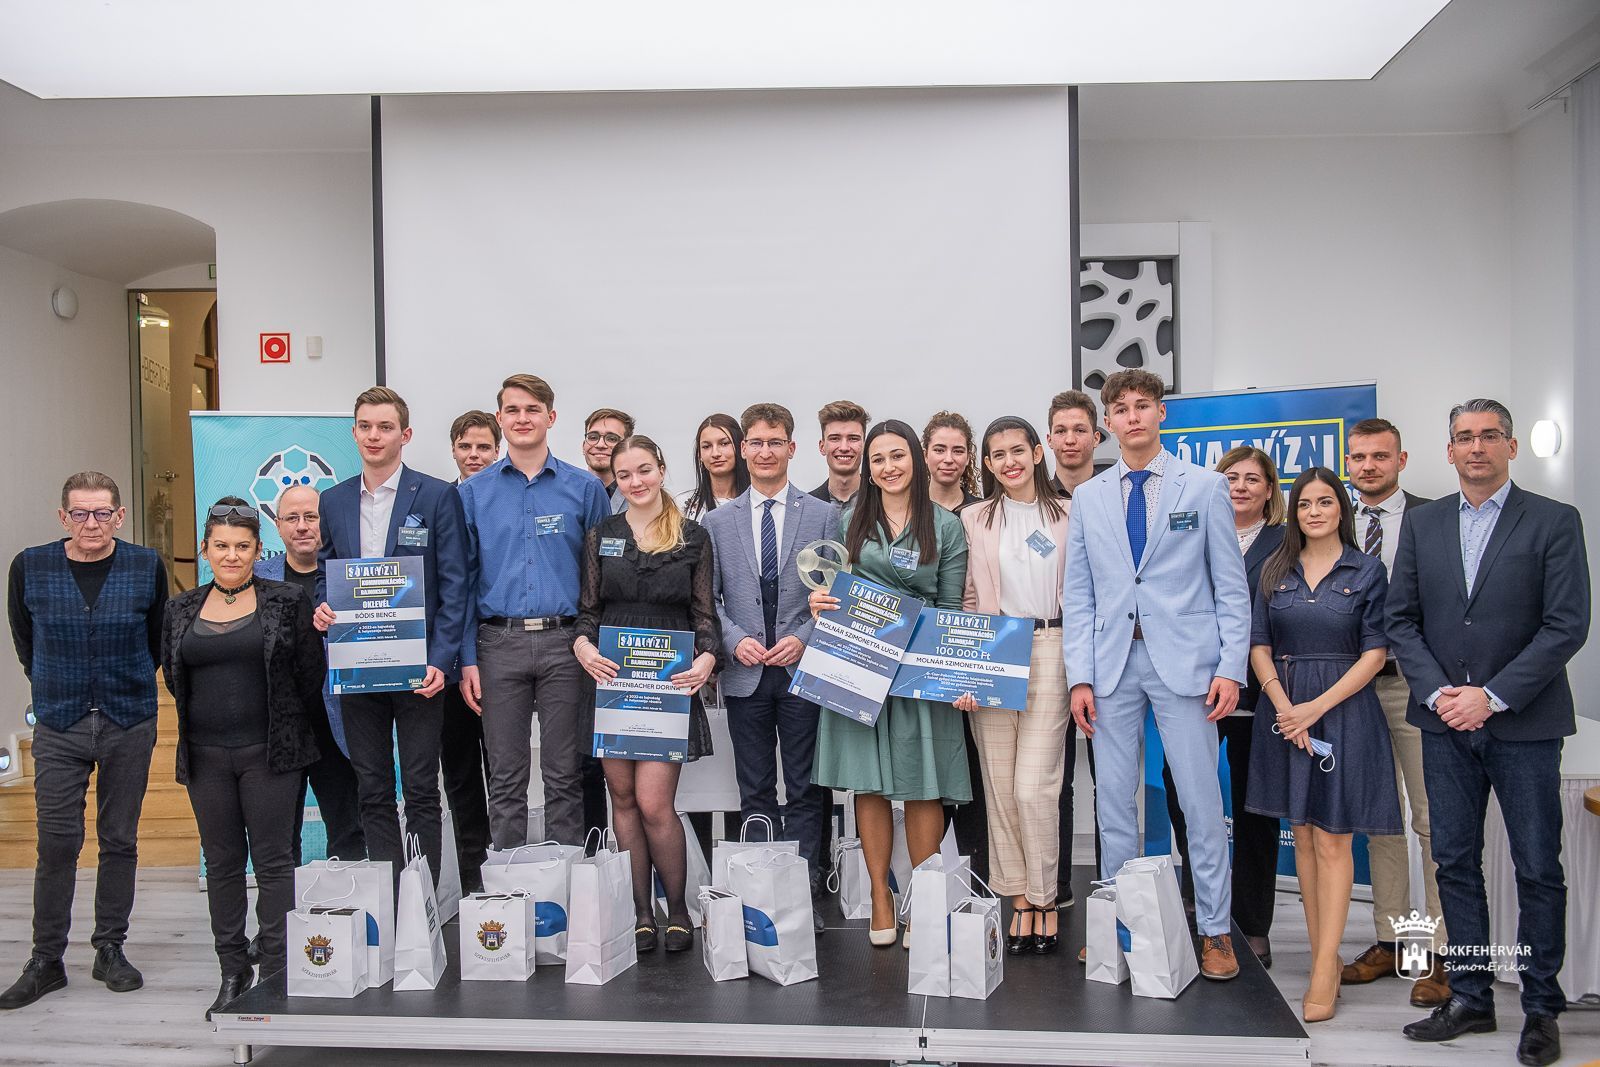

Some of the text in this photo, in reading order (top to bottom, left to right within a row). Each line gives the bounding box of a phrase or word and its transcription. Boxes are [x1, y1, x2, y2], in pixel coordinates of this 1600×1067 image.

[363, 599, 391, 609] OKLEVÉL
[850, 620, 876, 636] OKLEVÉL
[951, 628, 993, 639] KOMMUNIKÁCIÓS
[818, 619, 899, 656] MOLNÁR SZIMONETTA LUCIA
[633, 650, 675, 658] KOMMUNIKÁCIÓS
[936, 647, 990, 660] 100 000 Ft
[916, 655, 1005, 672] MOLNÁR SZIMONETTA LUCIA
[631, 670, 658, 679] OKLEVÉL
